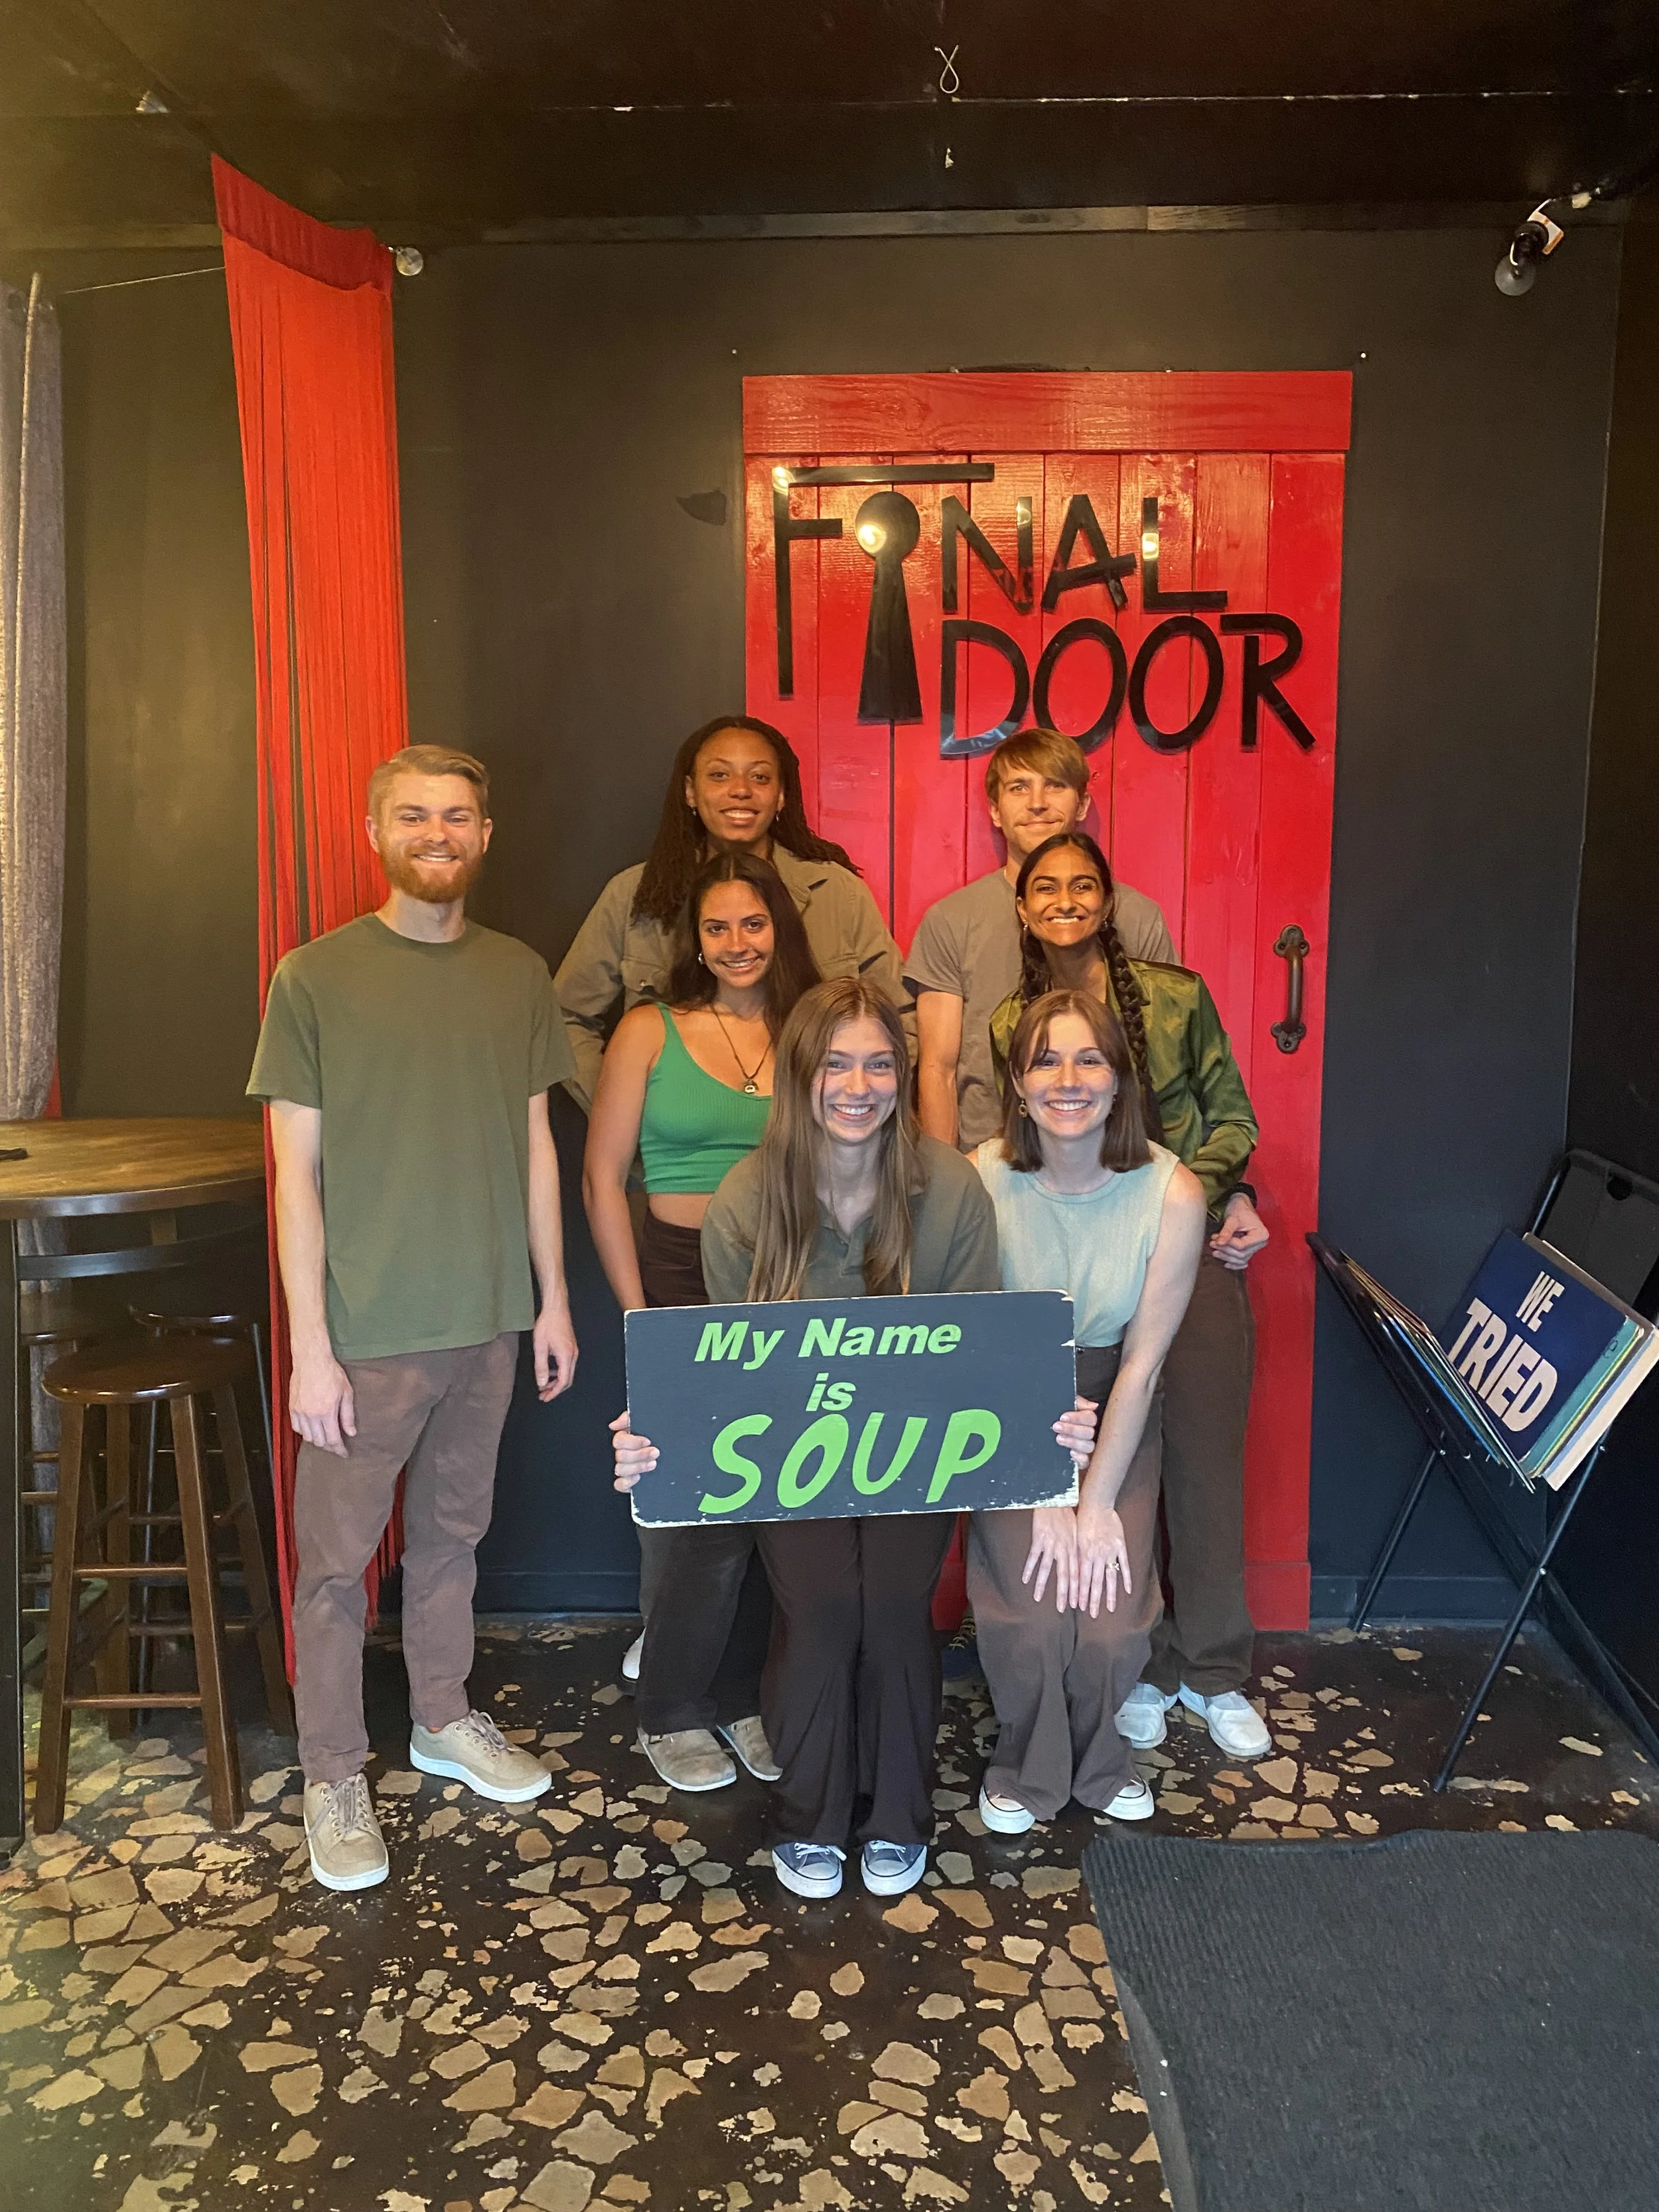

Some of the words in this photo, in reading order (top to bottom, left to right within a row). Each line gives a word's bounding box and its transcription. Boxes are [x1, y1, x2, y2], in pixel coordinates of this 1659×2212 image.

[940, 613, 1317, 759] DOOR
[1516, 1271, 1565, 1332] WE
[694, 1321, 785, 1370] My
[798, 1317, 962, 1357] Name
[1447, 1297, 1558, 1432] TRIED
[805, 1372, 856, 1412] is
[698, 1408, 1001, 1514] SOUP
